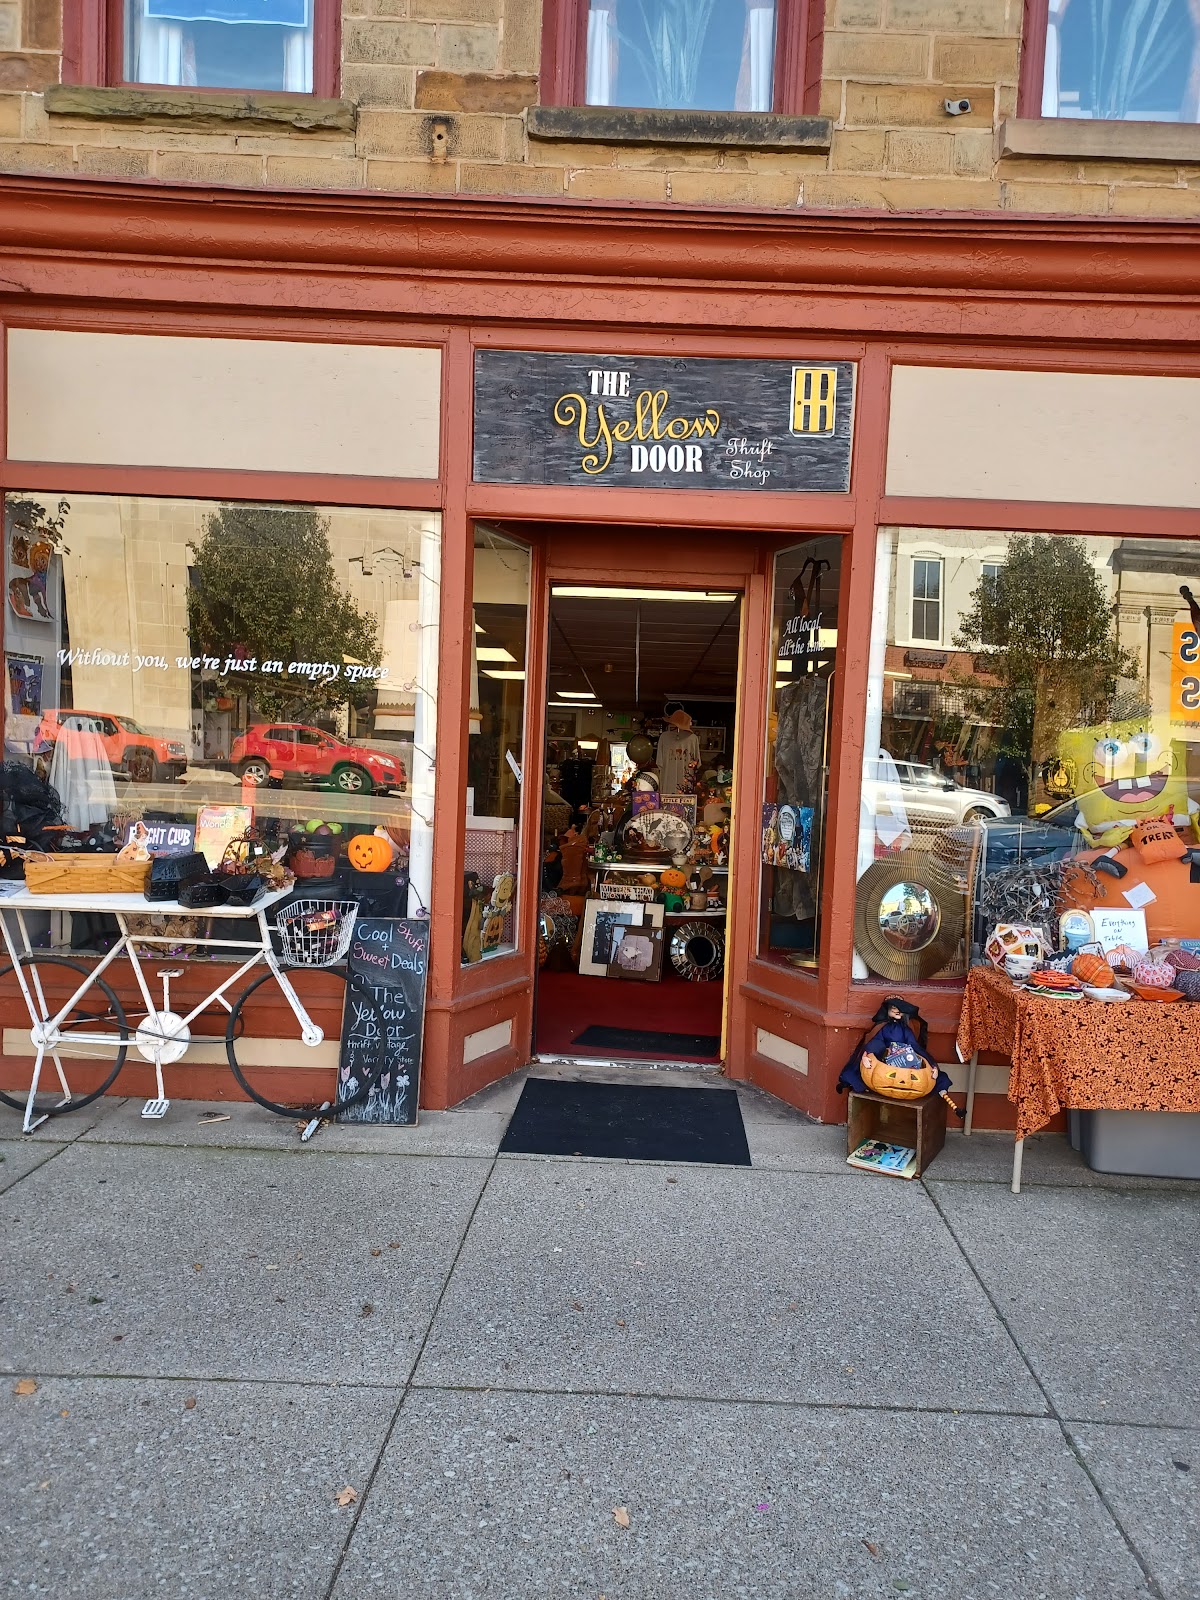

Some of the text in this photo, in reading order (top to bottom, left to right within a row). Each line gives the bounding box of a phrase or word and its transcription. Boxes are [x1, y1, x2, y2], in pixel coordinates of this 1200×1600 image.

[588, 370, 630, 397] THE
[553, 390, 720, 475] Yellow
[630, 445, 703, 473] DOOR
[725, 438, 773, 461] Thrift
[729, 460, 771, 485] Shop
[783, 615, 800, 637] All
[778, 638, 825, 656] all the time
[57, 647, 389, 682] Without you, we're just an empty space
[129, 826, 191, 846] FGHT CLUB
[1141, 831, 1175, 845] TREAT
[1101, 917, 1136, 928] Everything
[357, 921, 425, 952] Cool Stuff
[352, 941, 424, 975] Sweet Deals
[369, 986, 404, 1004] The
[351, 1001, 406, 1031] Yelow
[375, 1038, 409, 1056] vtage,
